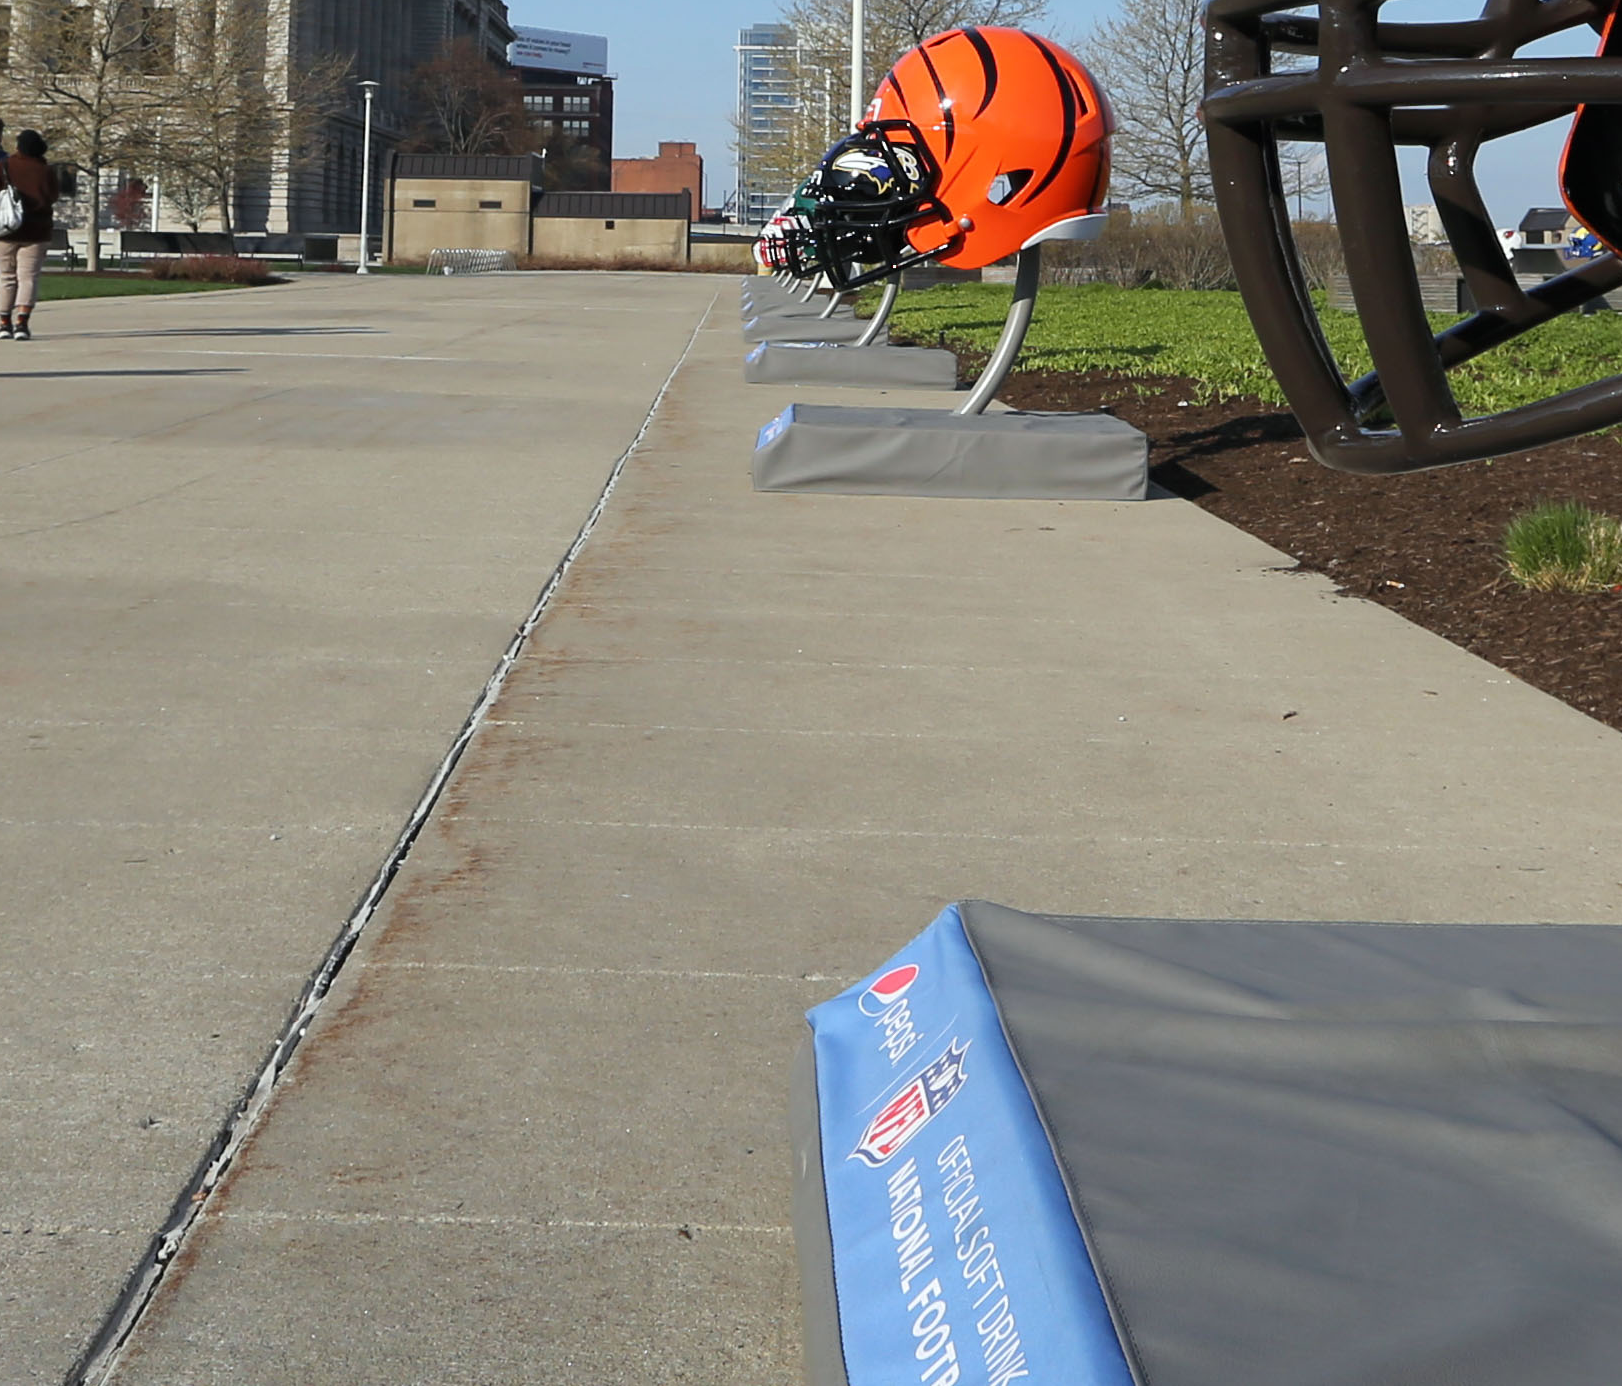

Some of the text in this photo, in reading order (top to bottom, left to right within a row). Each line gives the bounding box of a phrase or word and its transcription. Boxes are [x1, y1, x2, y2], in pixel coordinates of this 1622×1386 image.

[875, 998, 924, 1068] pepsi
[887, 1157, 934, 1294] NATIONAL
[937, 1134, 1029, 1386] OFFICIAL SOFT DRINK
